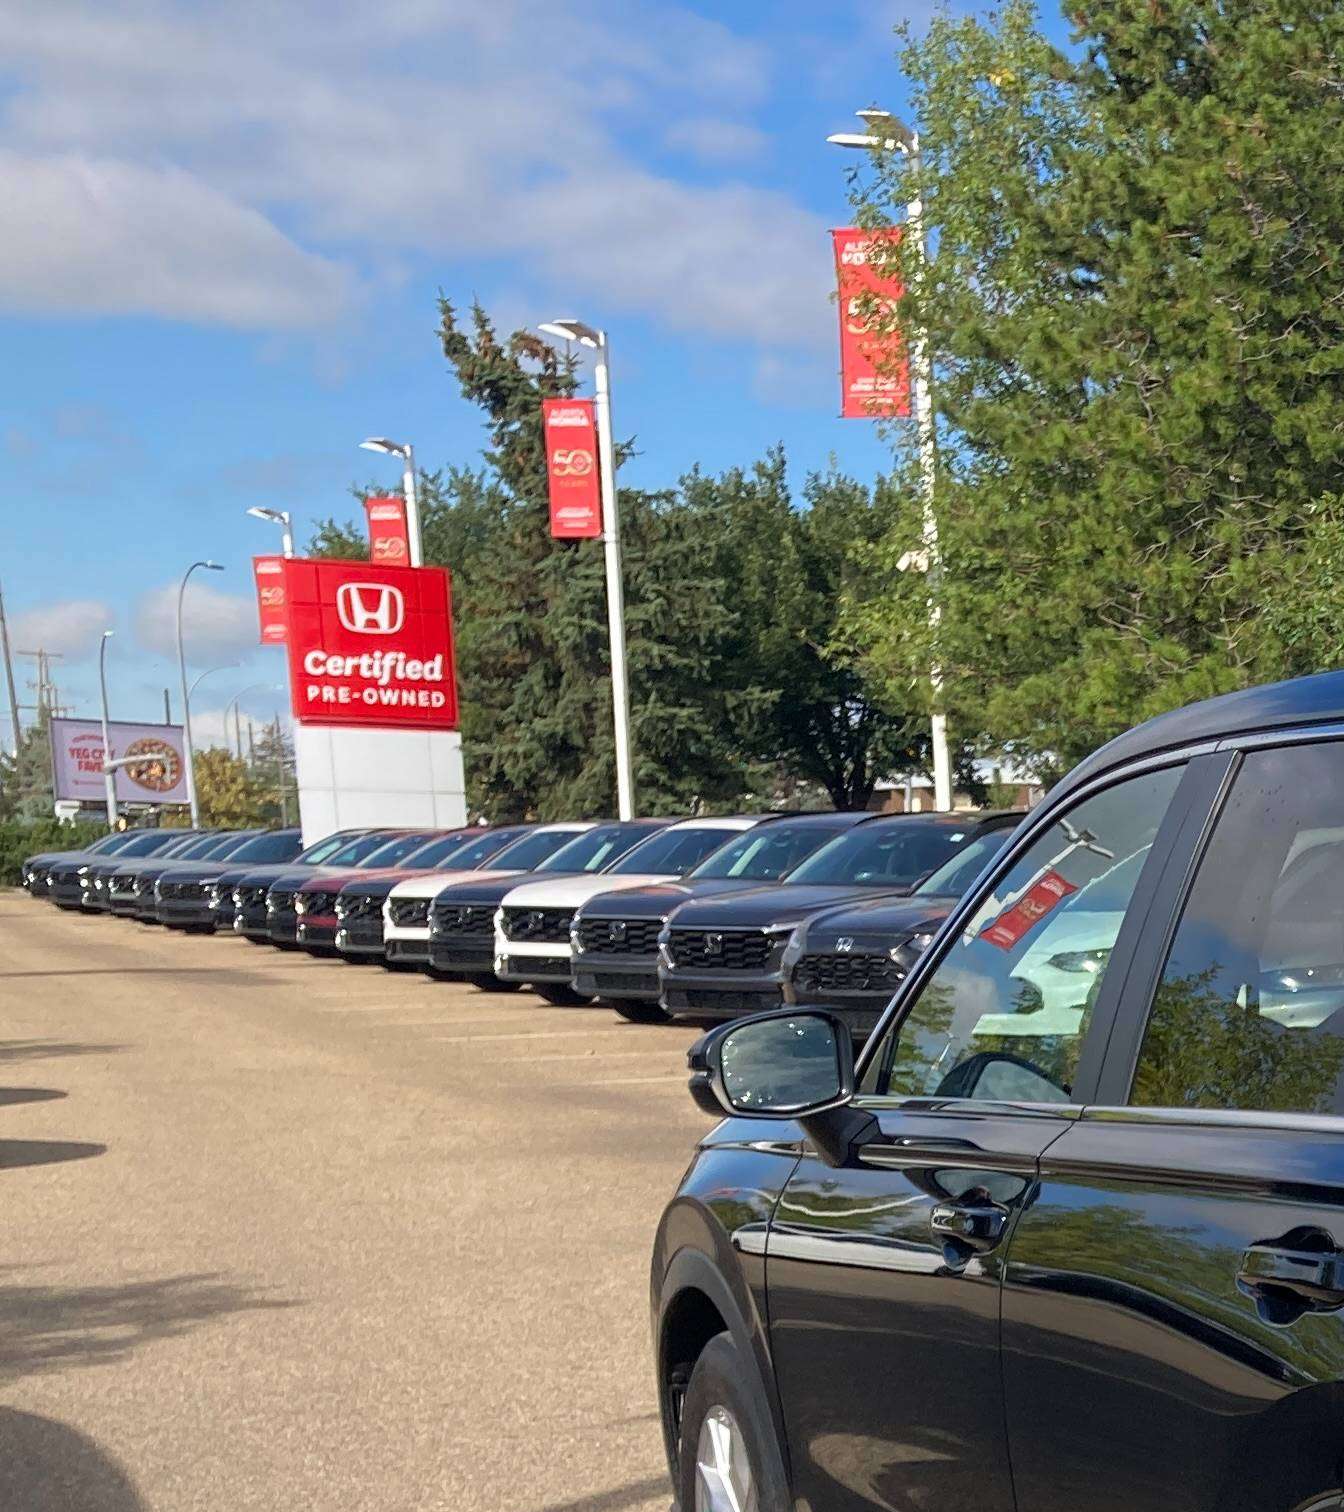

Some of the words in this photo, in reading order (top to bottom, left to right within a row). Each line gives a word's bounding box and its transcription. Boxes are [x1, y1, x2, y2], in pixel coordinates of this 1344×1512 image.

[553, 449, 594, 477] 50
[304, 650, 444, 686] Certified
[307, 685, 446, 708] PRE-OWNED
